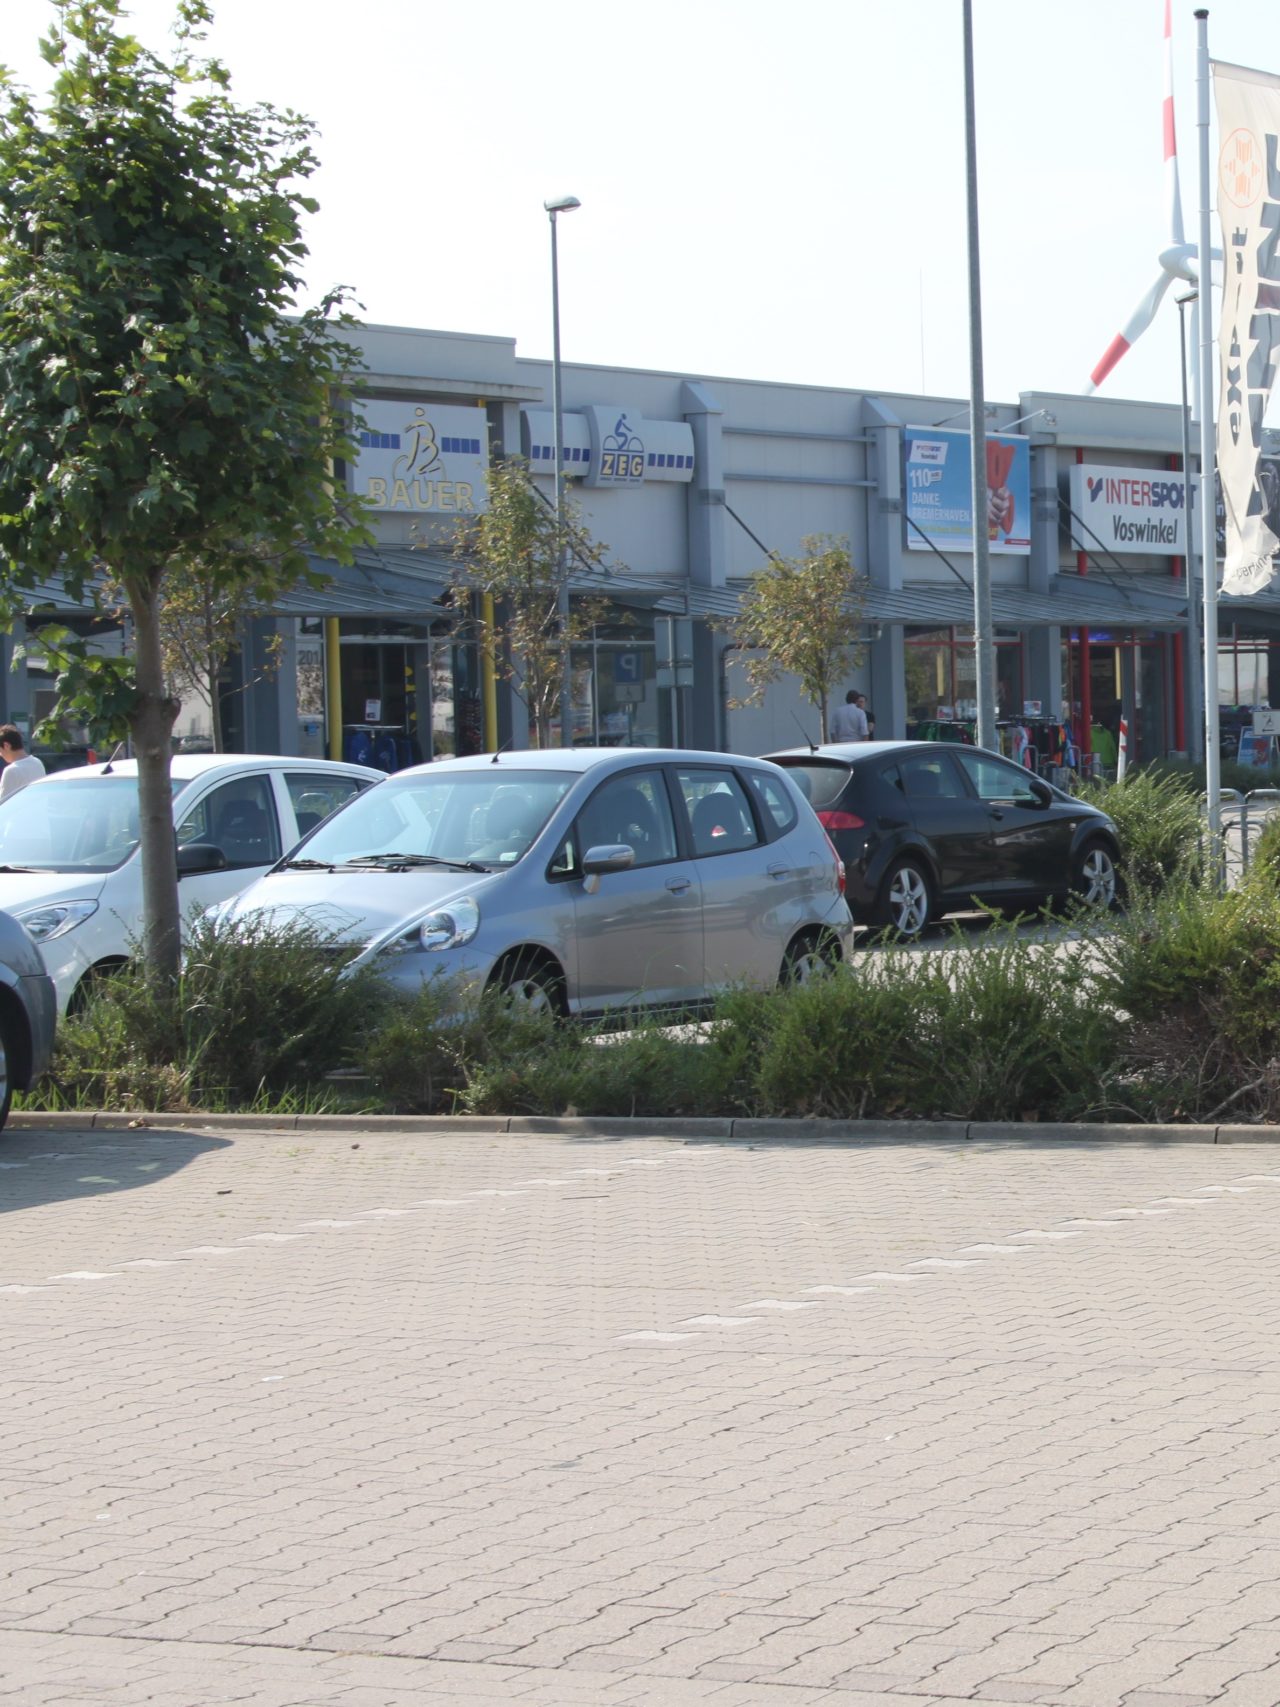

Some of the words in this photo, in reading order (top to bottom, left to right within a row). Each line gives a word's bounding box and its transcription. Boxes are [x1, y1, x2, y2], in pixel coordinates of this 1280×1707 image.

[1226, 227, 1248, 447] exprt
[601, 454, 643, 476] ZEG
[367, 477, 475, 511] BAUER
[1112, 514, 1178, 544] Voswinkel
